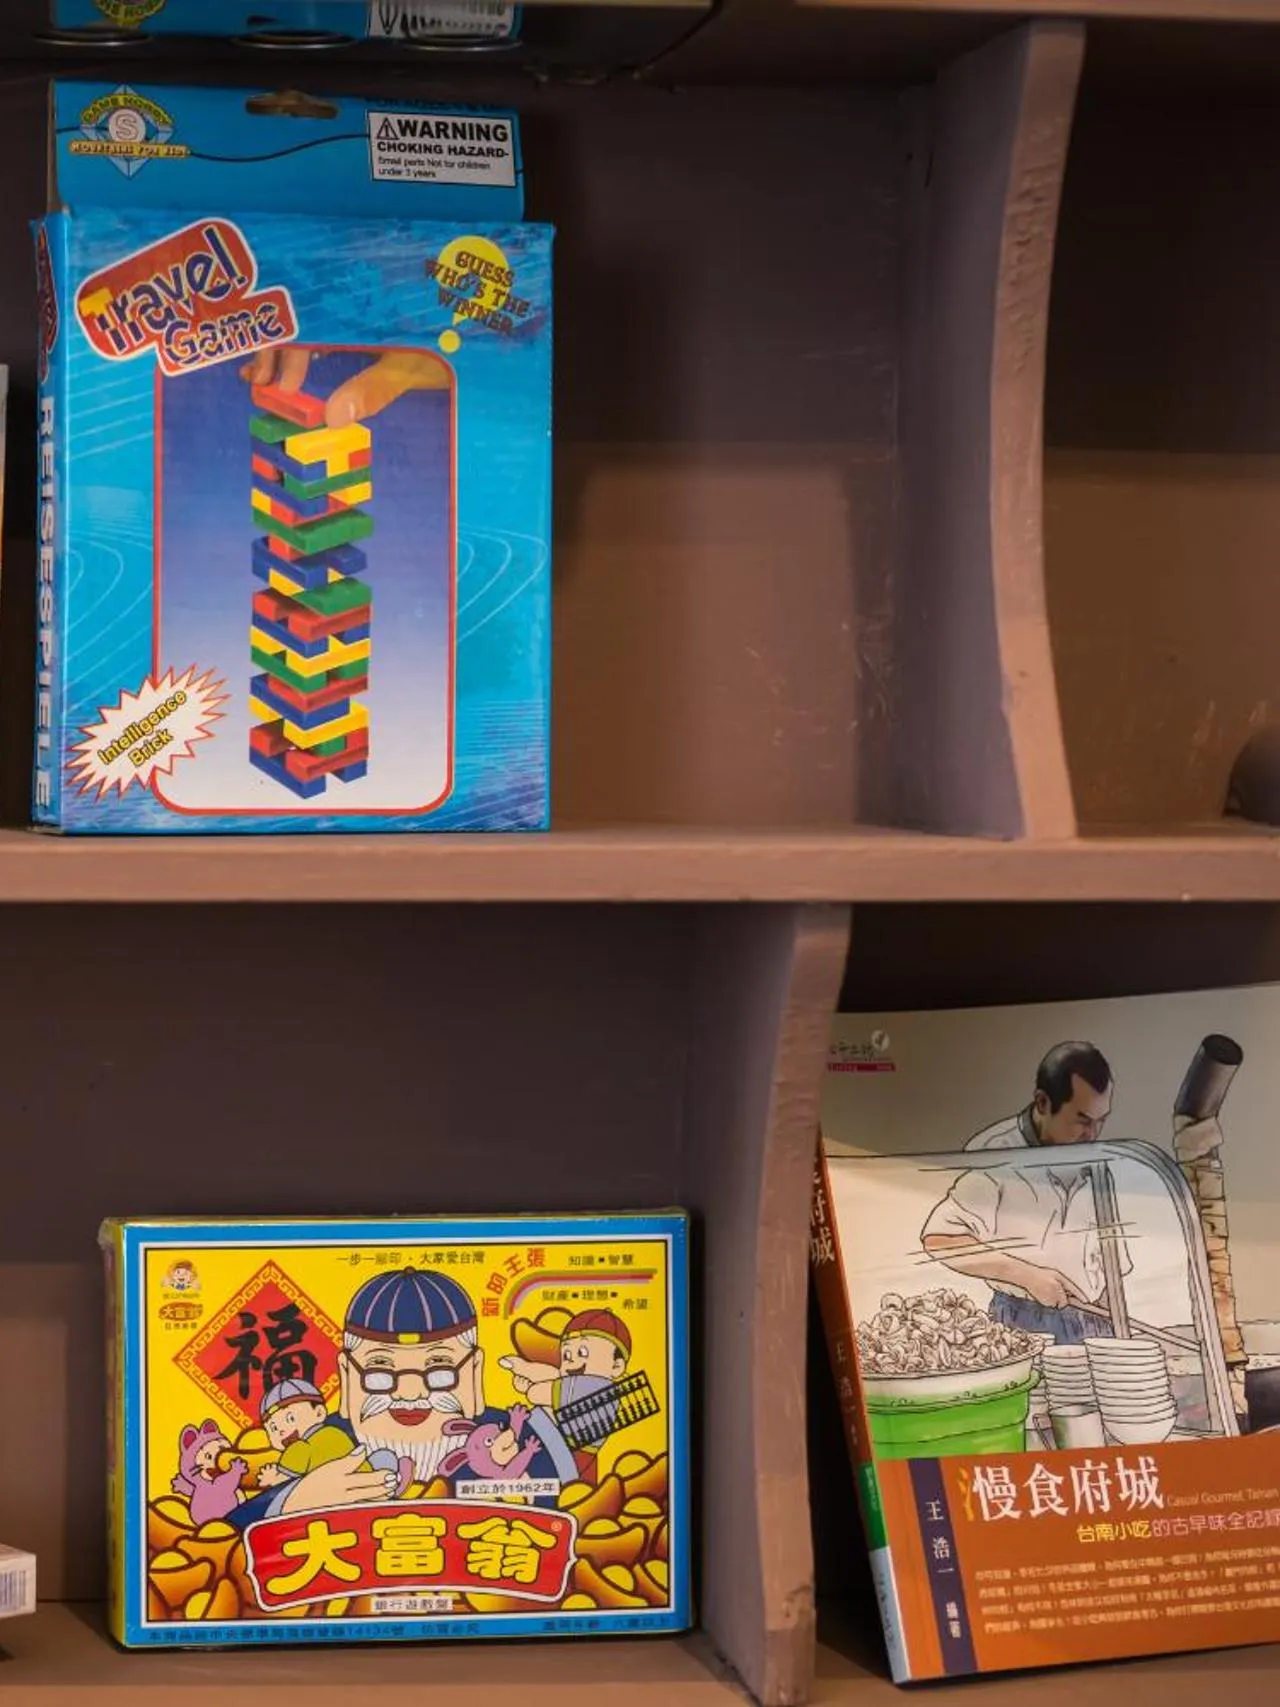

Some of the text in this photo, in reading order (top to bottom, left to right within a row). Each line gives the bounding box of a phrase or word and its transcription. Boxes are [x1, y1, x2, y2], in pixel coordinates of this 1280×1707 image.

[377, 141, 444, 155] CHOKING
[397, 119, 508, 142] WARNING
[378, 168, 402, 177] under
[404, 158, 425, 168] parts
[427, 158, 442, 168] Not
[444, 159, 456, 168] for
[457, 159, 491, 170] children
[454, 250, 516, 288] GUESS
[79, 224, 248, 355] Travel
[492, 288, 531, 318] THE
[163, 302, 285, 366] Game
[97, 690, 187, 766] Intelligence
[128, 728, 174, 768] Brick
[623, 1298, 648, 1310] 希望
[211, 1302, 320, 1401] 福
[461, 1482, 555, 1495] 創立於1962年
[266, 1512, 557, 1596] 大富翁
[925, 1499, 955, 1573] 王浩一
